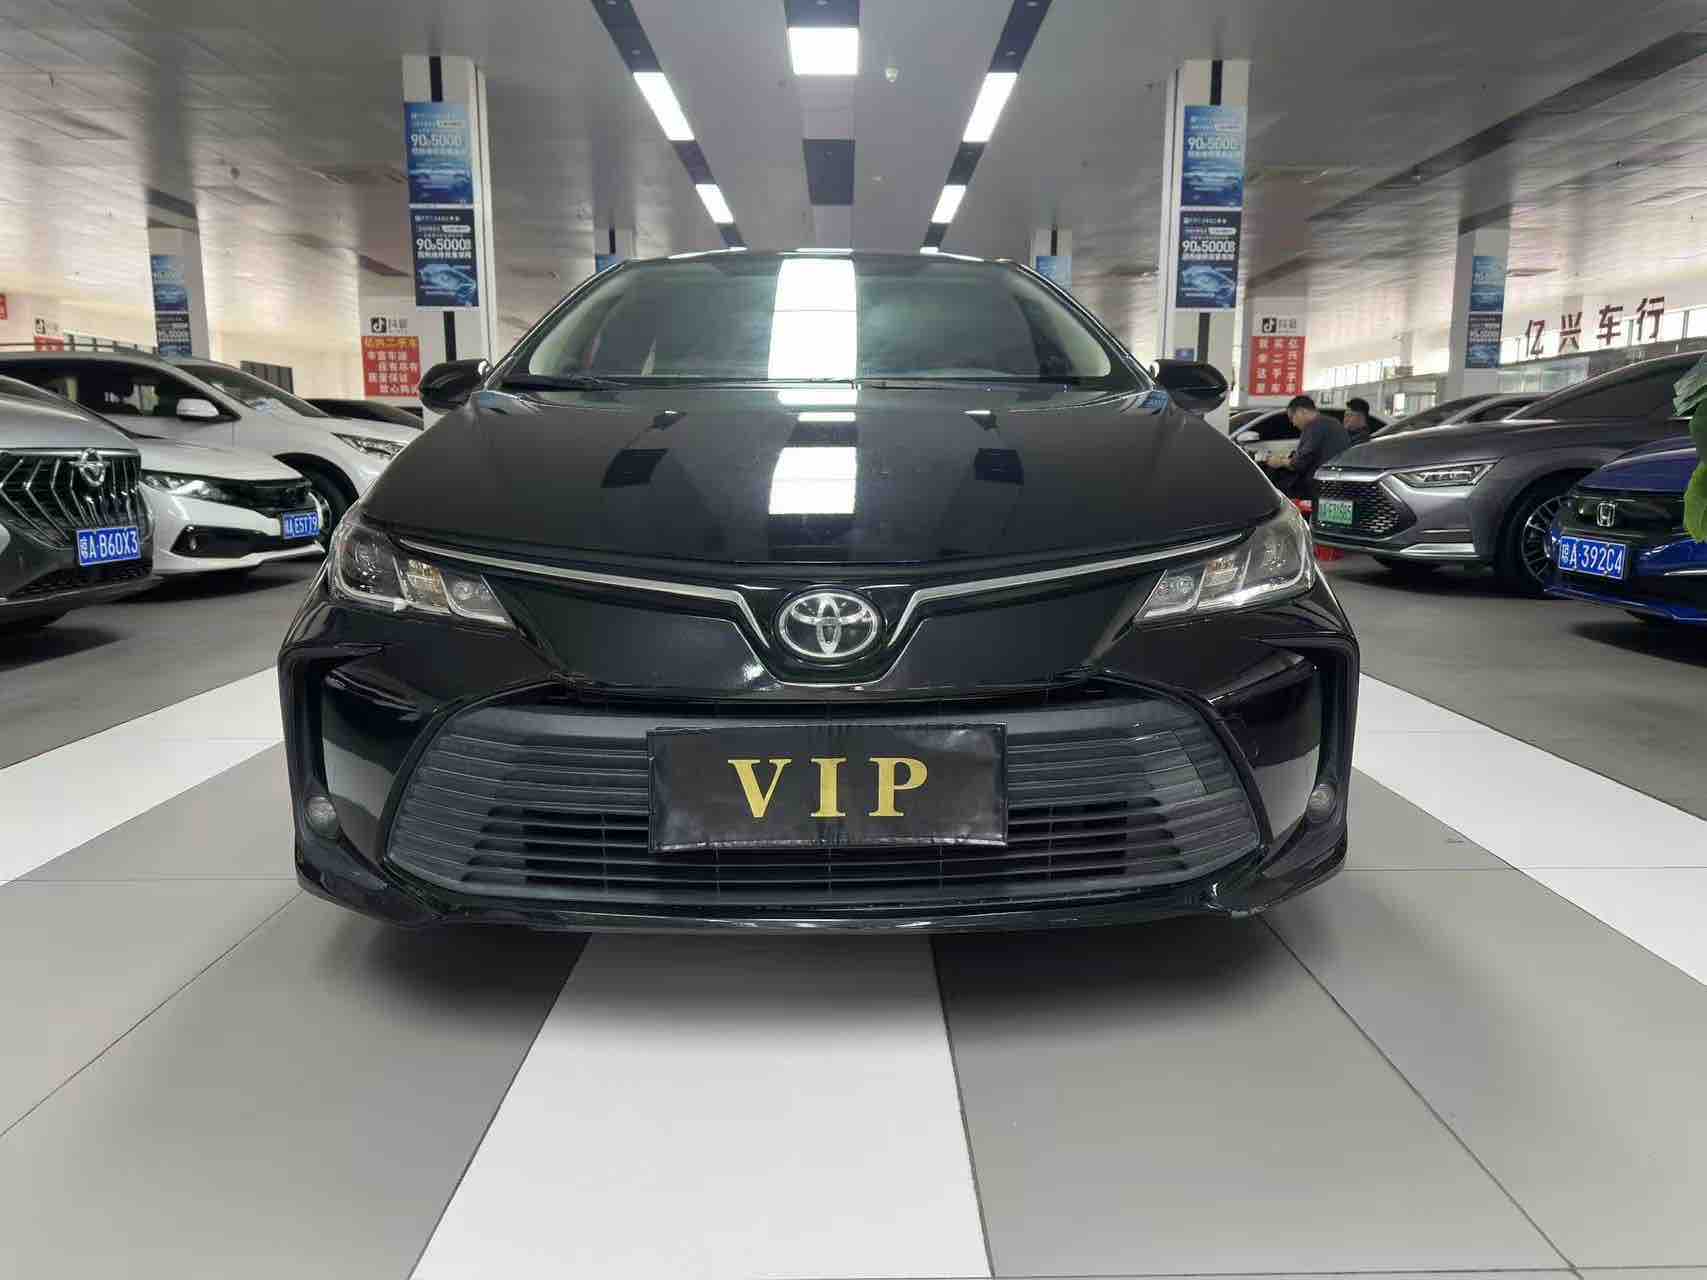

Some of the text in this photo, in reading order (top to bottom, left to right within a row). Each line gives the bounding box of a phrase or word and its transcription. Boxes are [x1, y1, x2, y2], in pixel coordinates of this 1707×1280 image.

[1525, 297, 1665, 357] 亿兴车行
[728, 756, 928, 818] VIP
